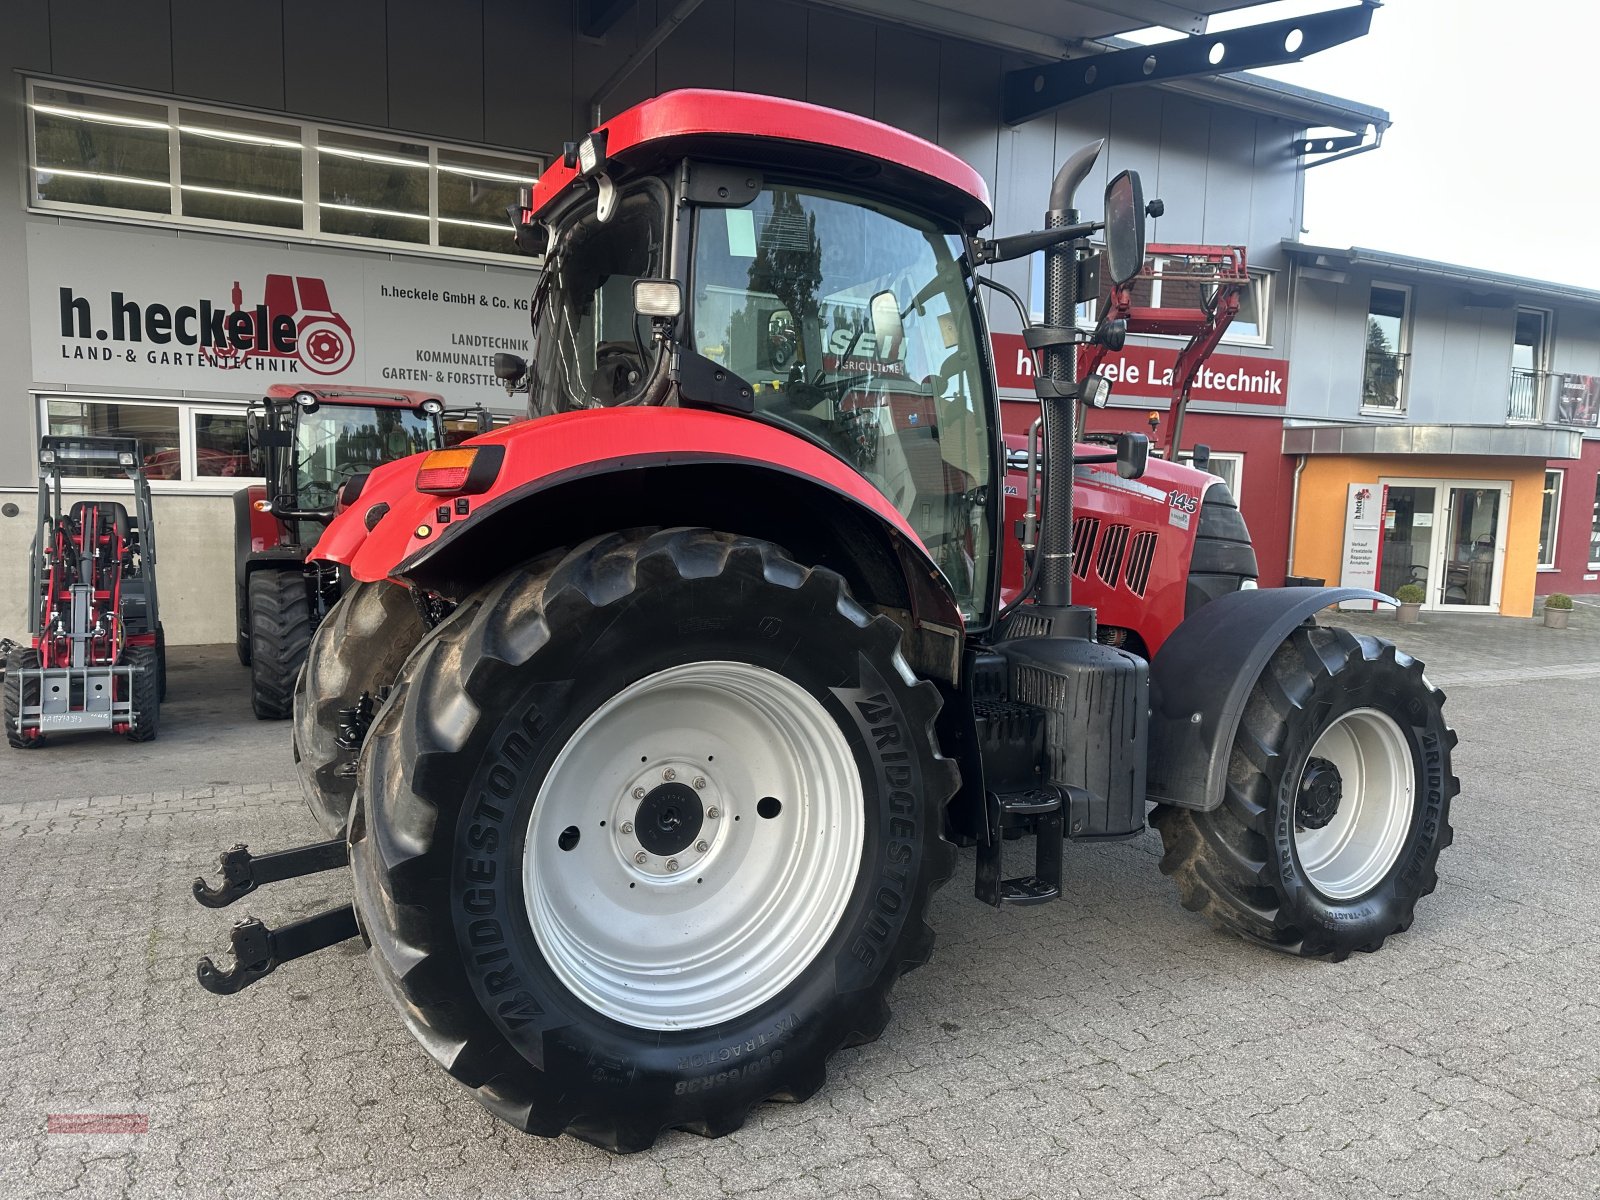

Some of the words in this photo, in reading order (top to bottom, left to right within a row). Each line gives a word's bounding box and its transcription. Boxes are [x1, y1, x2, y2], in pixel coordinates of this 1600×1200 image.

[380, 285, 439, 302] h.heckele
[443, 291, 475, 305] GmbH
[480, 295, 489, 306] &
[492, 296, 510, 309] Co.
[514, 299, 529, 311] KG
[60, 286, 298, 354] h.heckele
[451, 333, 529, 352] LANDTECHNIK
[147, 349, 299, 374] GARTENTECHNIK
[416, 349, 528, 369] KOMMUNALTE
[382, 367, 433, 382] GARTEN-
[436, 370, 445, 383] &
[1148, 358, 1282, 395] Ladtechnik
[1169, 489, 1198, 513] 145
[1401, 731, 1441, 886] BRIDGESTONE
[852, 692, 915, 968] BRIDGESTONE
[463, 704, 548, 1031] BRIDGESTONE
